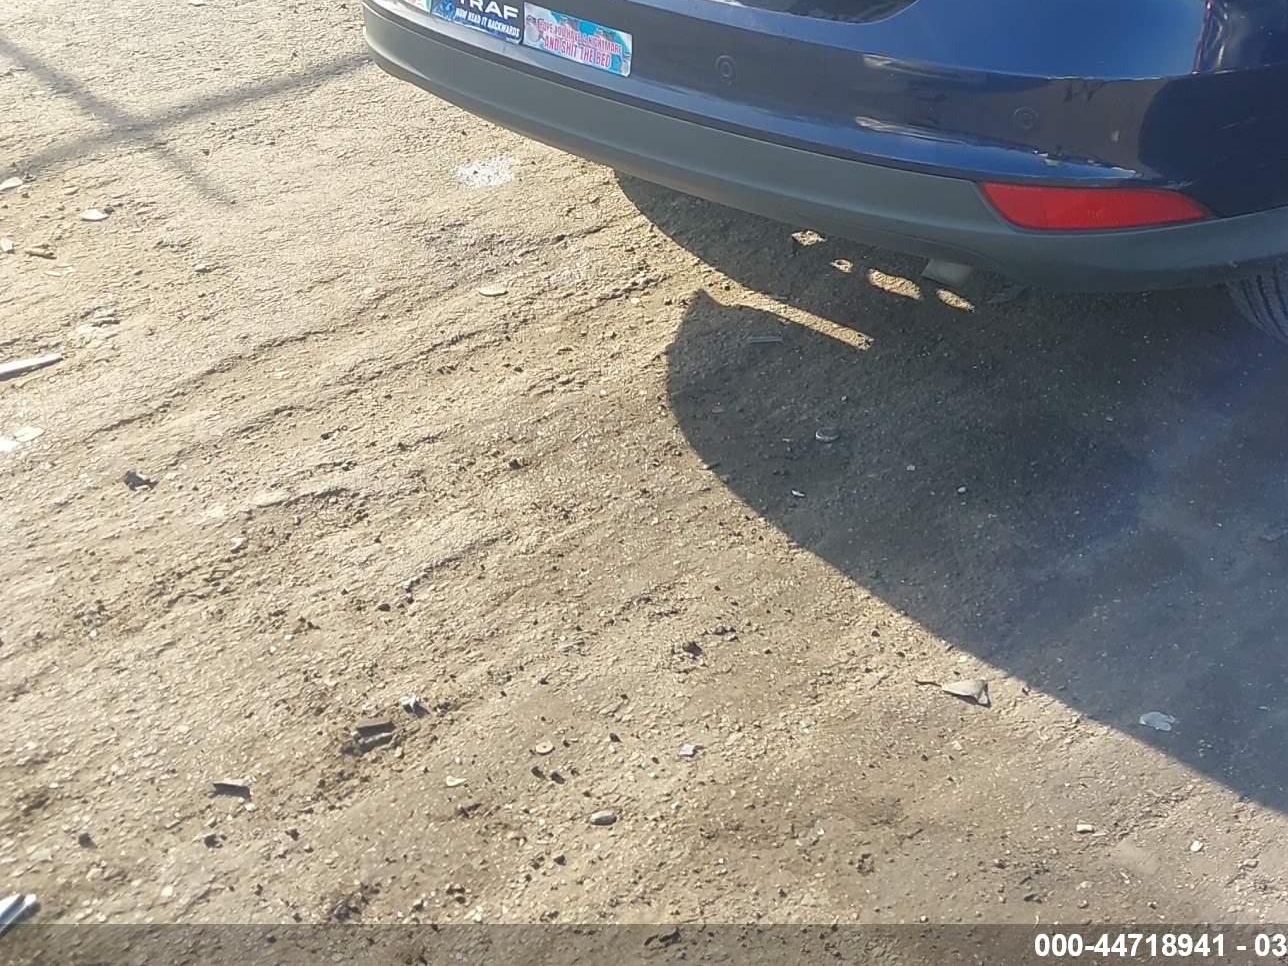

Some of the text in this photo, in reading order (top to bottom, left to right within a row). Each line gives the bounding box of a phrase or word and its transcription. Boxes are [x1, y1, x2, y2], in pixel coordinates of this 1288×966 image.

[467, 11, 481, 24] READ
[481, 16, 488, 28] IT
[487, 18, 520, 38] BACKWARDS
[543, 35, 611, 68] AND SHIT THE BED
[554, 25, 567, 37] YOU
[588, 35, 622, 55] NIGHTMARE
